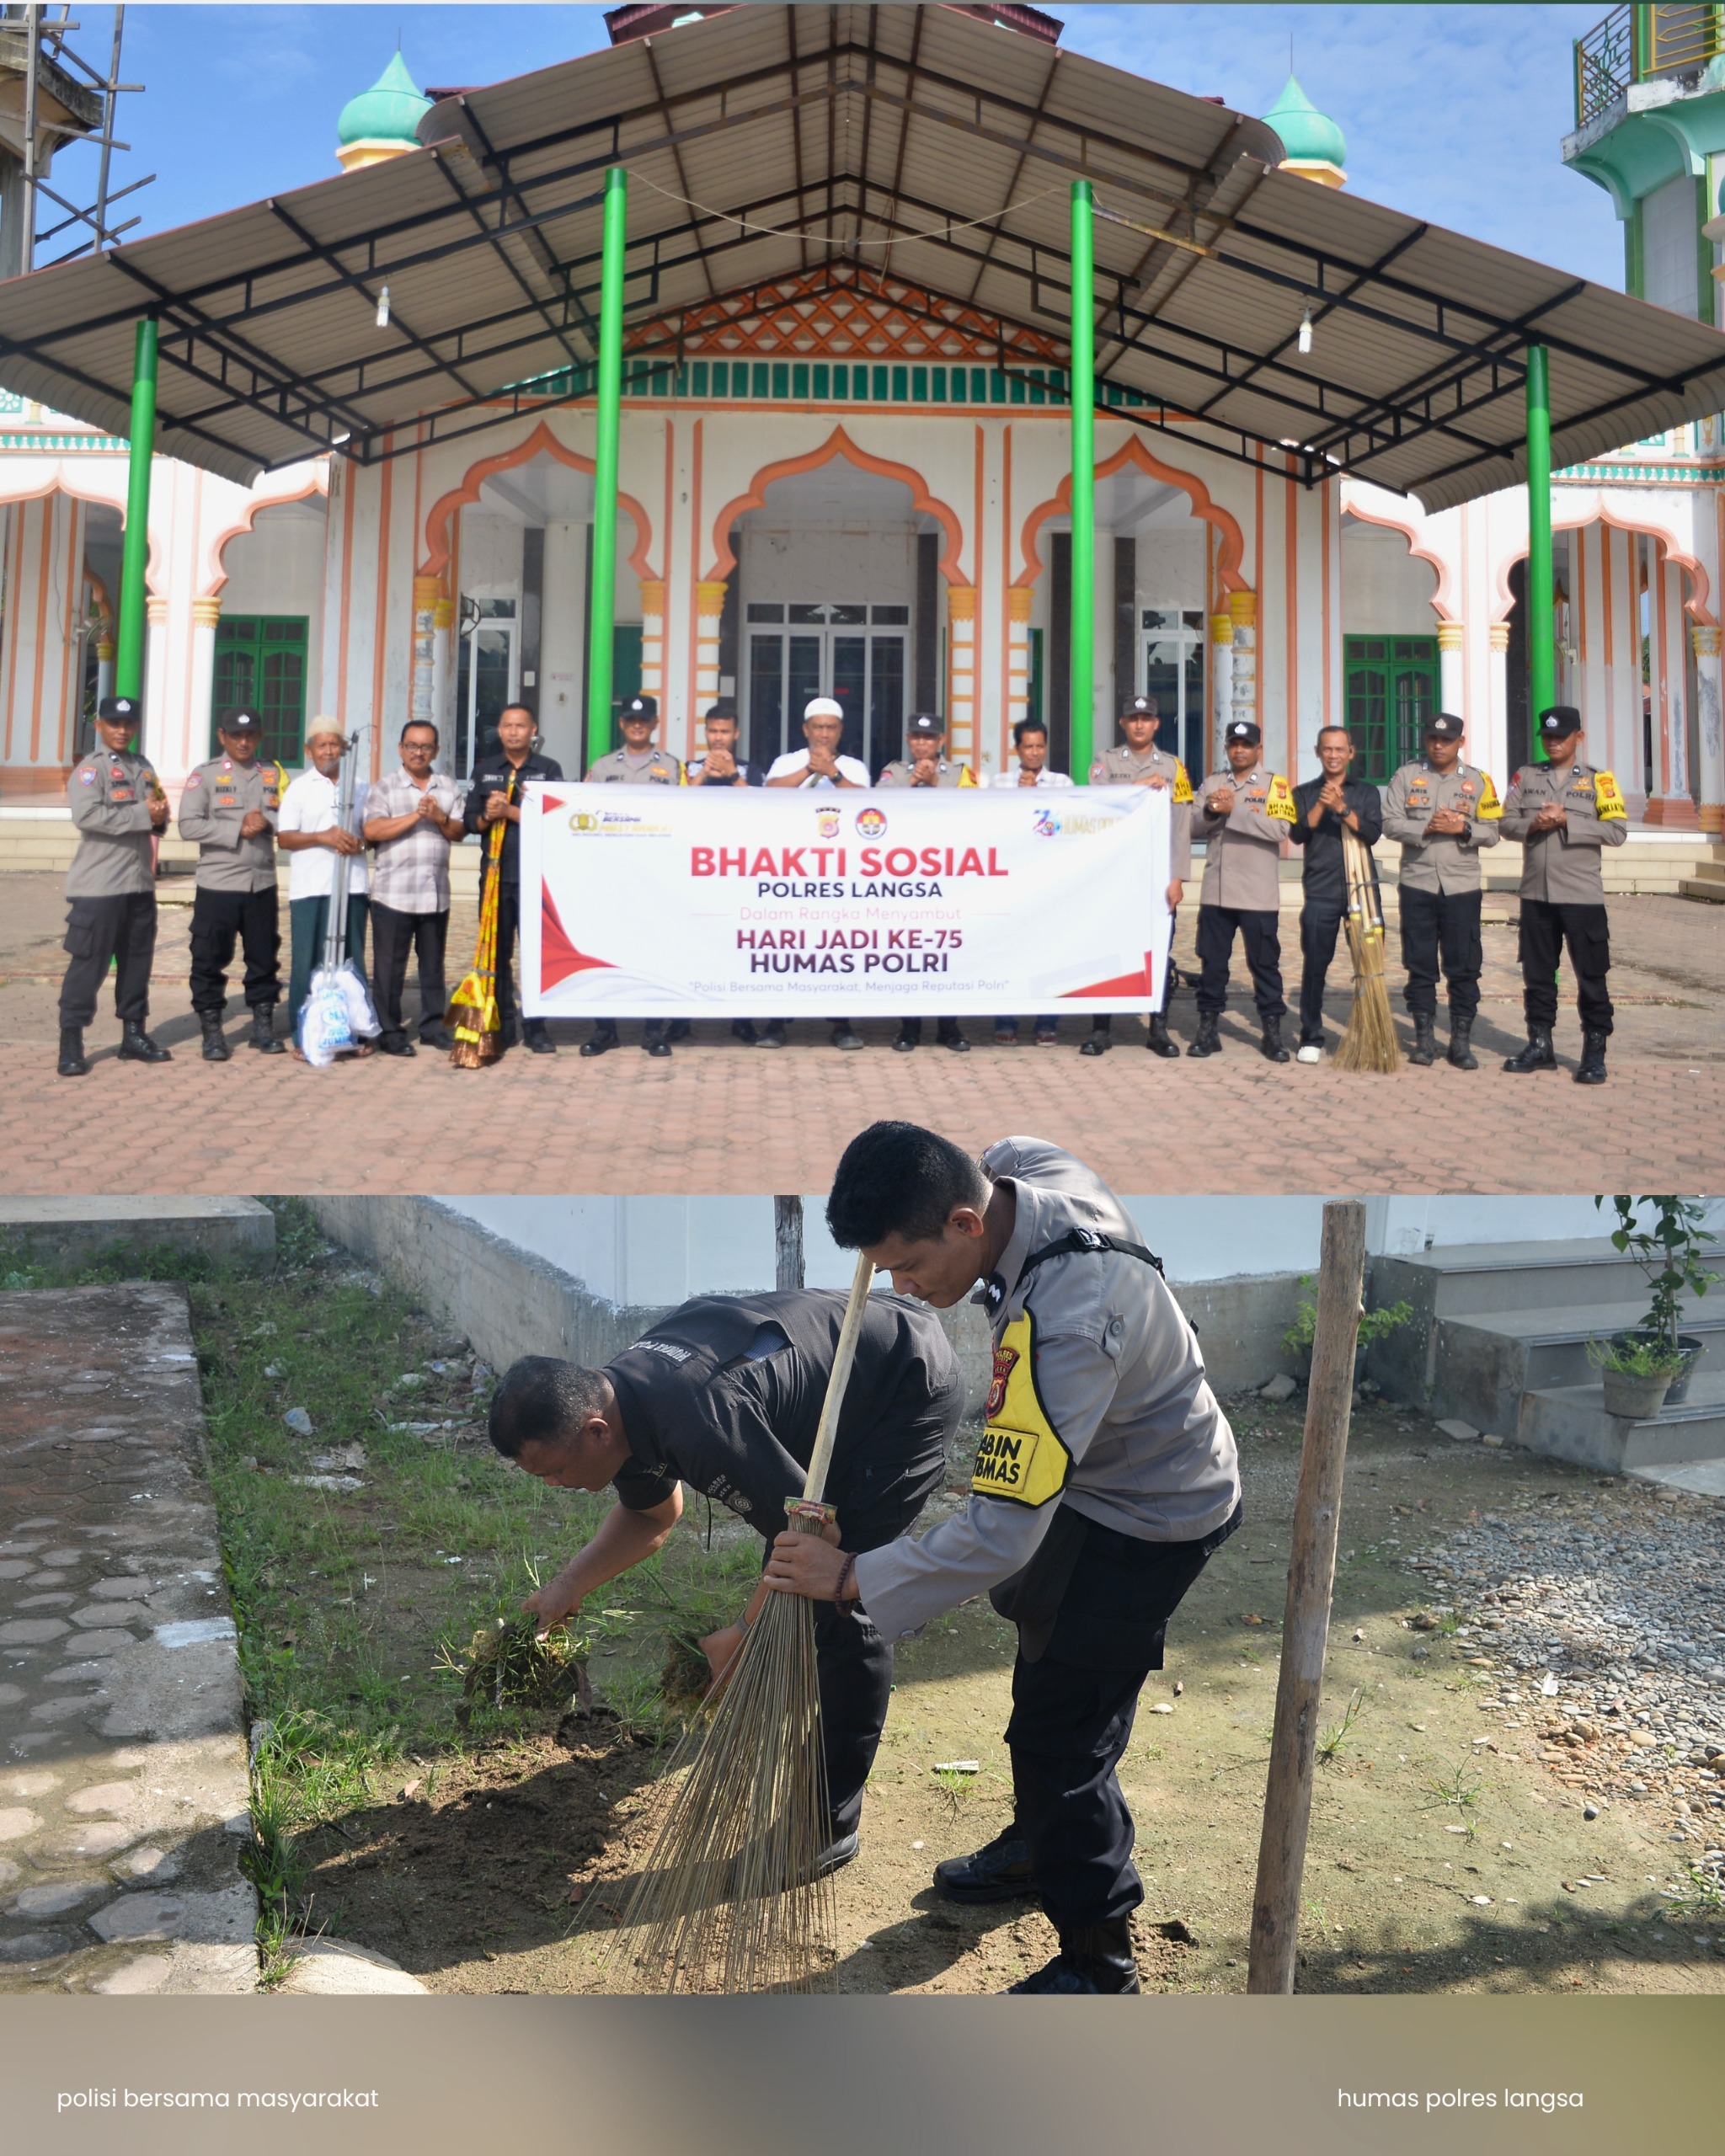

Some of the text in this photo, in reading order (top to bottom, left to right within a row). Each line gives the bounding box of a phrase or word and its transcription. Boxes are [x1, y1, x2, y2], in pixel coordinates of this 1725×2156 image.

[1453, 792, 1476, 802] POLRI
[1523, 787, 1546, 796] AWAN
[1565, 791, 1595, 802] POLRI
[1243, 796, 1266, 804] POLRI
[691, 847, 1009, 878] BHAKTI SOSIAL
[758, 882, 943, 898] POLRES LANGSA
[740, 907, 962, 924] Dalam Rangka Menyambut
[737, 929, 963, 950] HARI JADI KE-75
[750, 953, 948, 974] HUMAS POLRI
[729, 981, 784, 993] Bersama
[787, 981, 862, 994] Masyarakat,
[865, 980, 919, 994] Menjaga
[922, 979, 975, 993] Reputasi
